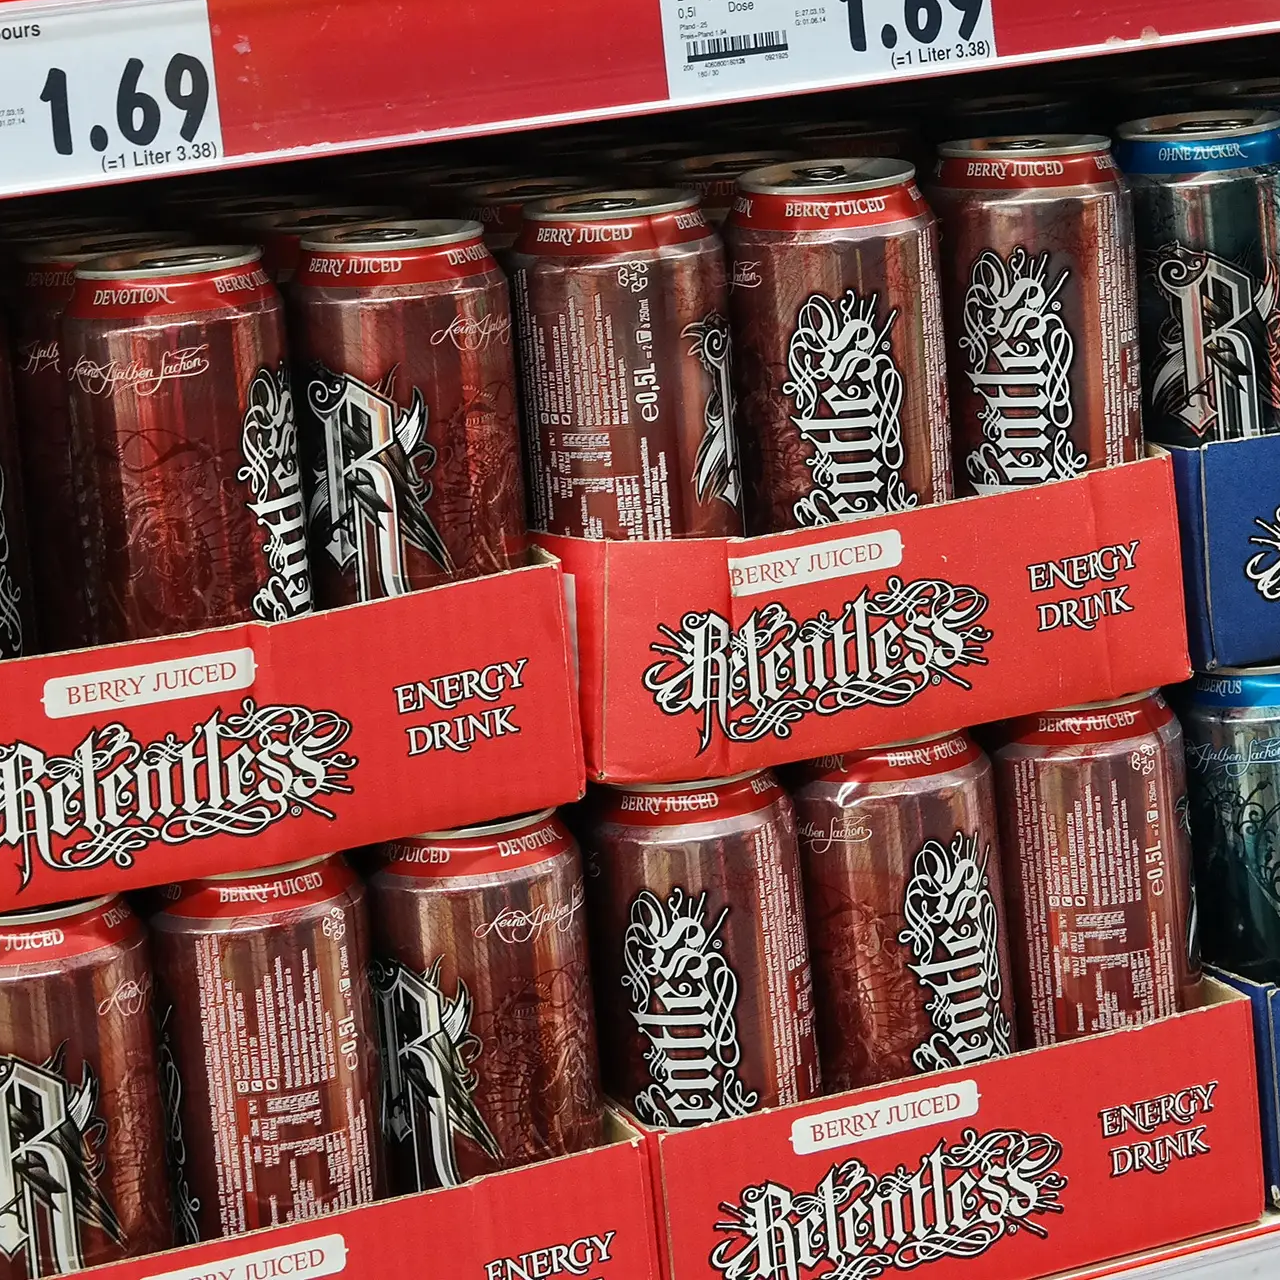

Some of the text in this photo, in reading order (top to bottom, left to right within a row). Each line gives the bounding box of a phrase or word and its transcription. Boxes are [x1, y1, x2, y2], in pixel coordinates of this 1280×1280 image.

[728, 0, 754, 13] Dose
[891, 40, 991, 70] (=1 Liter 3.38)
[40, 53, 210, 155] 1.69
[101, 141, 218, 173] (=1 Liter 3.38)
[966, 160, 1064, 180] BERRY JUICED
[1158, 141, 1248, 163] OHNE ZUCKER
[93, 287, 175, 308] DEVOTION
[729, 540, 883, 590] BERRY JUICED
[1028, 540, 1139, 594] ENERGY
[1037, 585, 1134, 633] DRINK
[66, 660, 237, 707] BERRY JUICED
[394, 658, 527, 716] ENERGY
[642, 575, 994, 758] Relentless
[406, 704, 520, 756] DRINK
[809, 1092, 961, 1145] BERRY JUICED
[1099, 1080, 1219, 1141] ENERGY
[1109, 1125, 1210, 1179] DRINK
